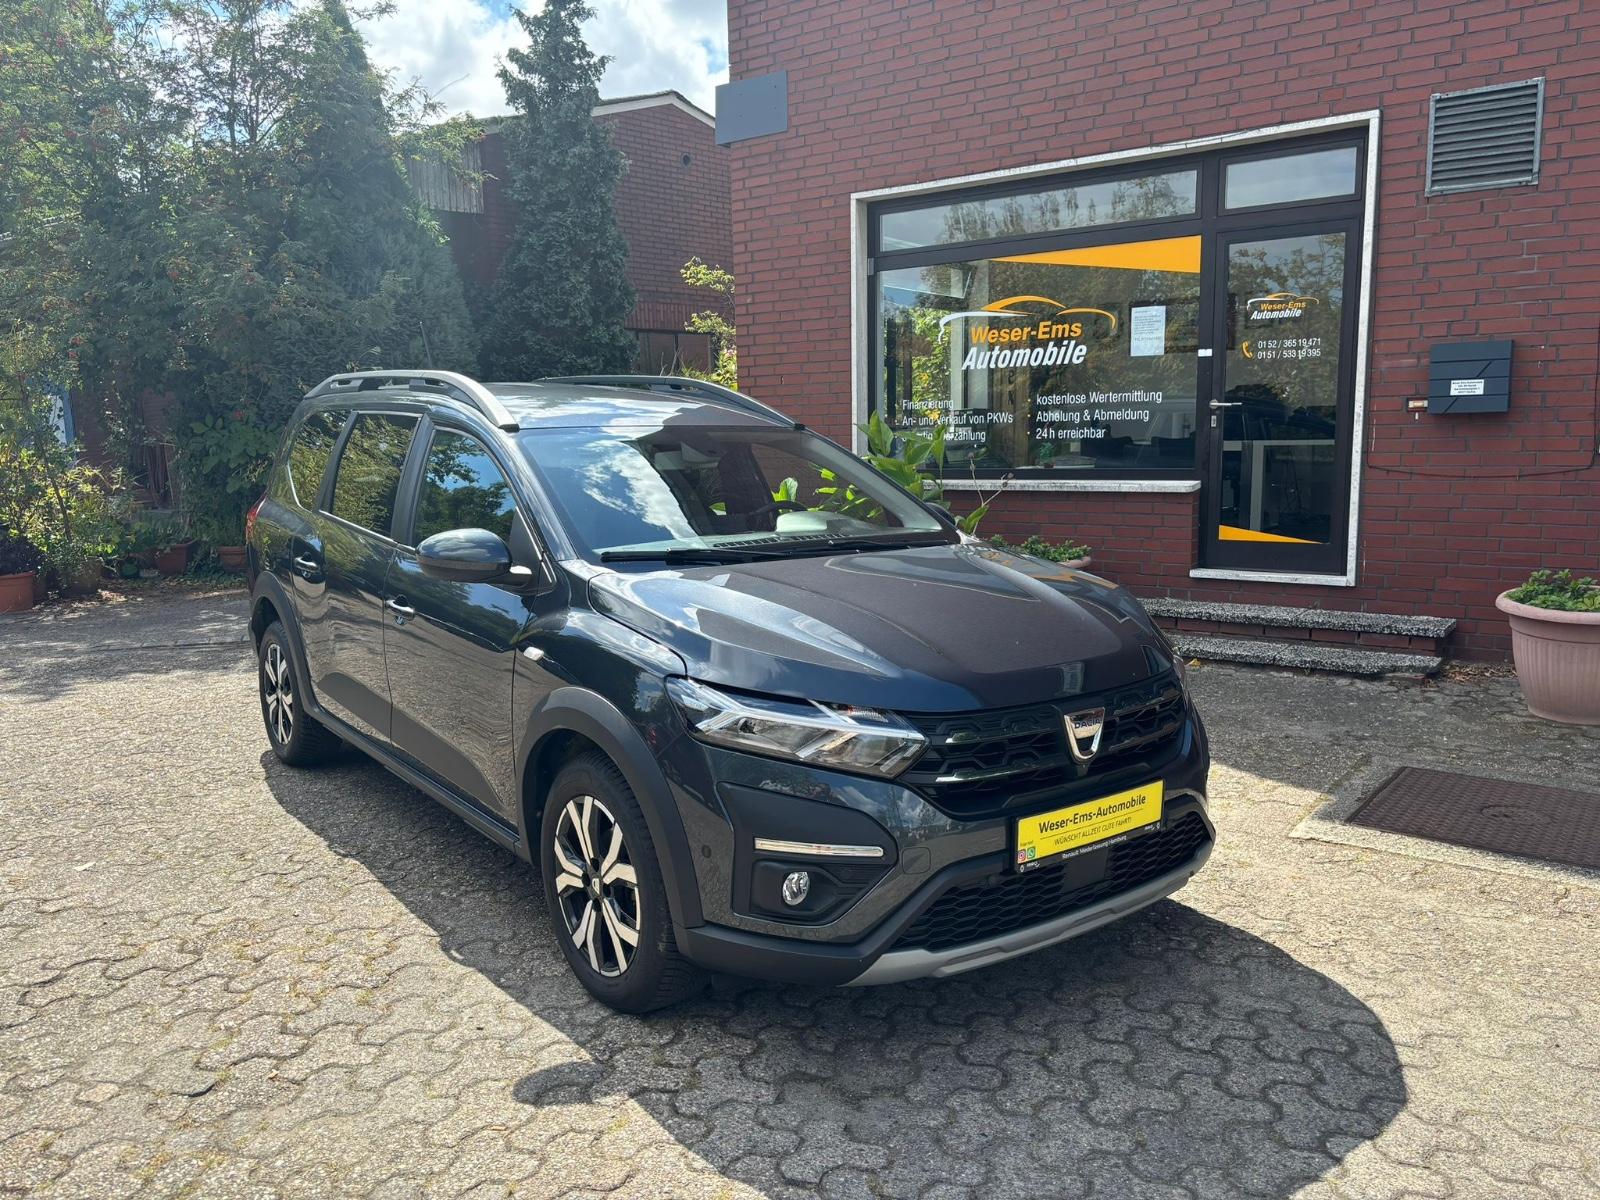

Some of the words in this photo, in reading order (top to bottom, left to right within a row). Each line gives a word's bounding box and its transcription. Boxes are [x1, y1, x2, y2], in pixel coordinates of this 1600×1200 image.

[1260, 302, 1306, 310] Weser-Ems
[1250, 308, 1302, 319] Automobile
[970, 321, 1082, 344] Weser-Ems
[961, 340, 1087, 370] Automobile
[1036, 393, 1086, 405] kostenlose
[1089, 390, 1162, 403] Wertermittlung
[902, 399, 954, 411] Finanzierung
[902, 415, 916, 426] An-
[969, 415, 984, 424] von
[987, 412, 1013, 424] PKWs
[1036, 411, 1080, 423] Abholung
[1083, 410, 1091, 421] &
[1093, 408, 1149, 422] Abmeldung
[1058, 426, 1106, 438] erreichbar
[1074, 718, 1101, 729] DACIA
[1039, 794, 1146, 833] Weser-Ems-Automobile
